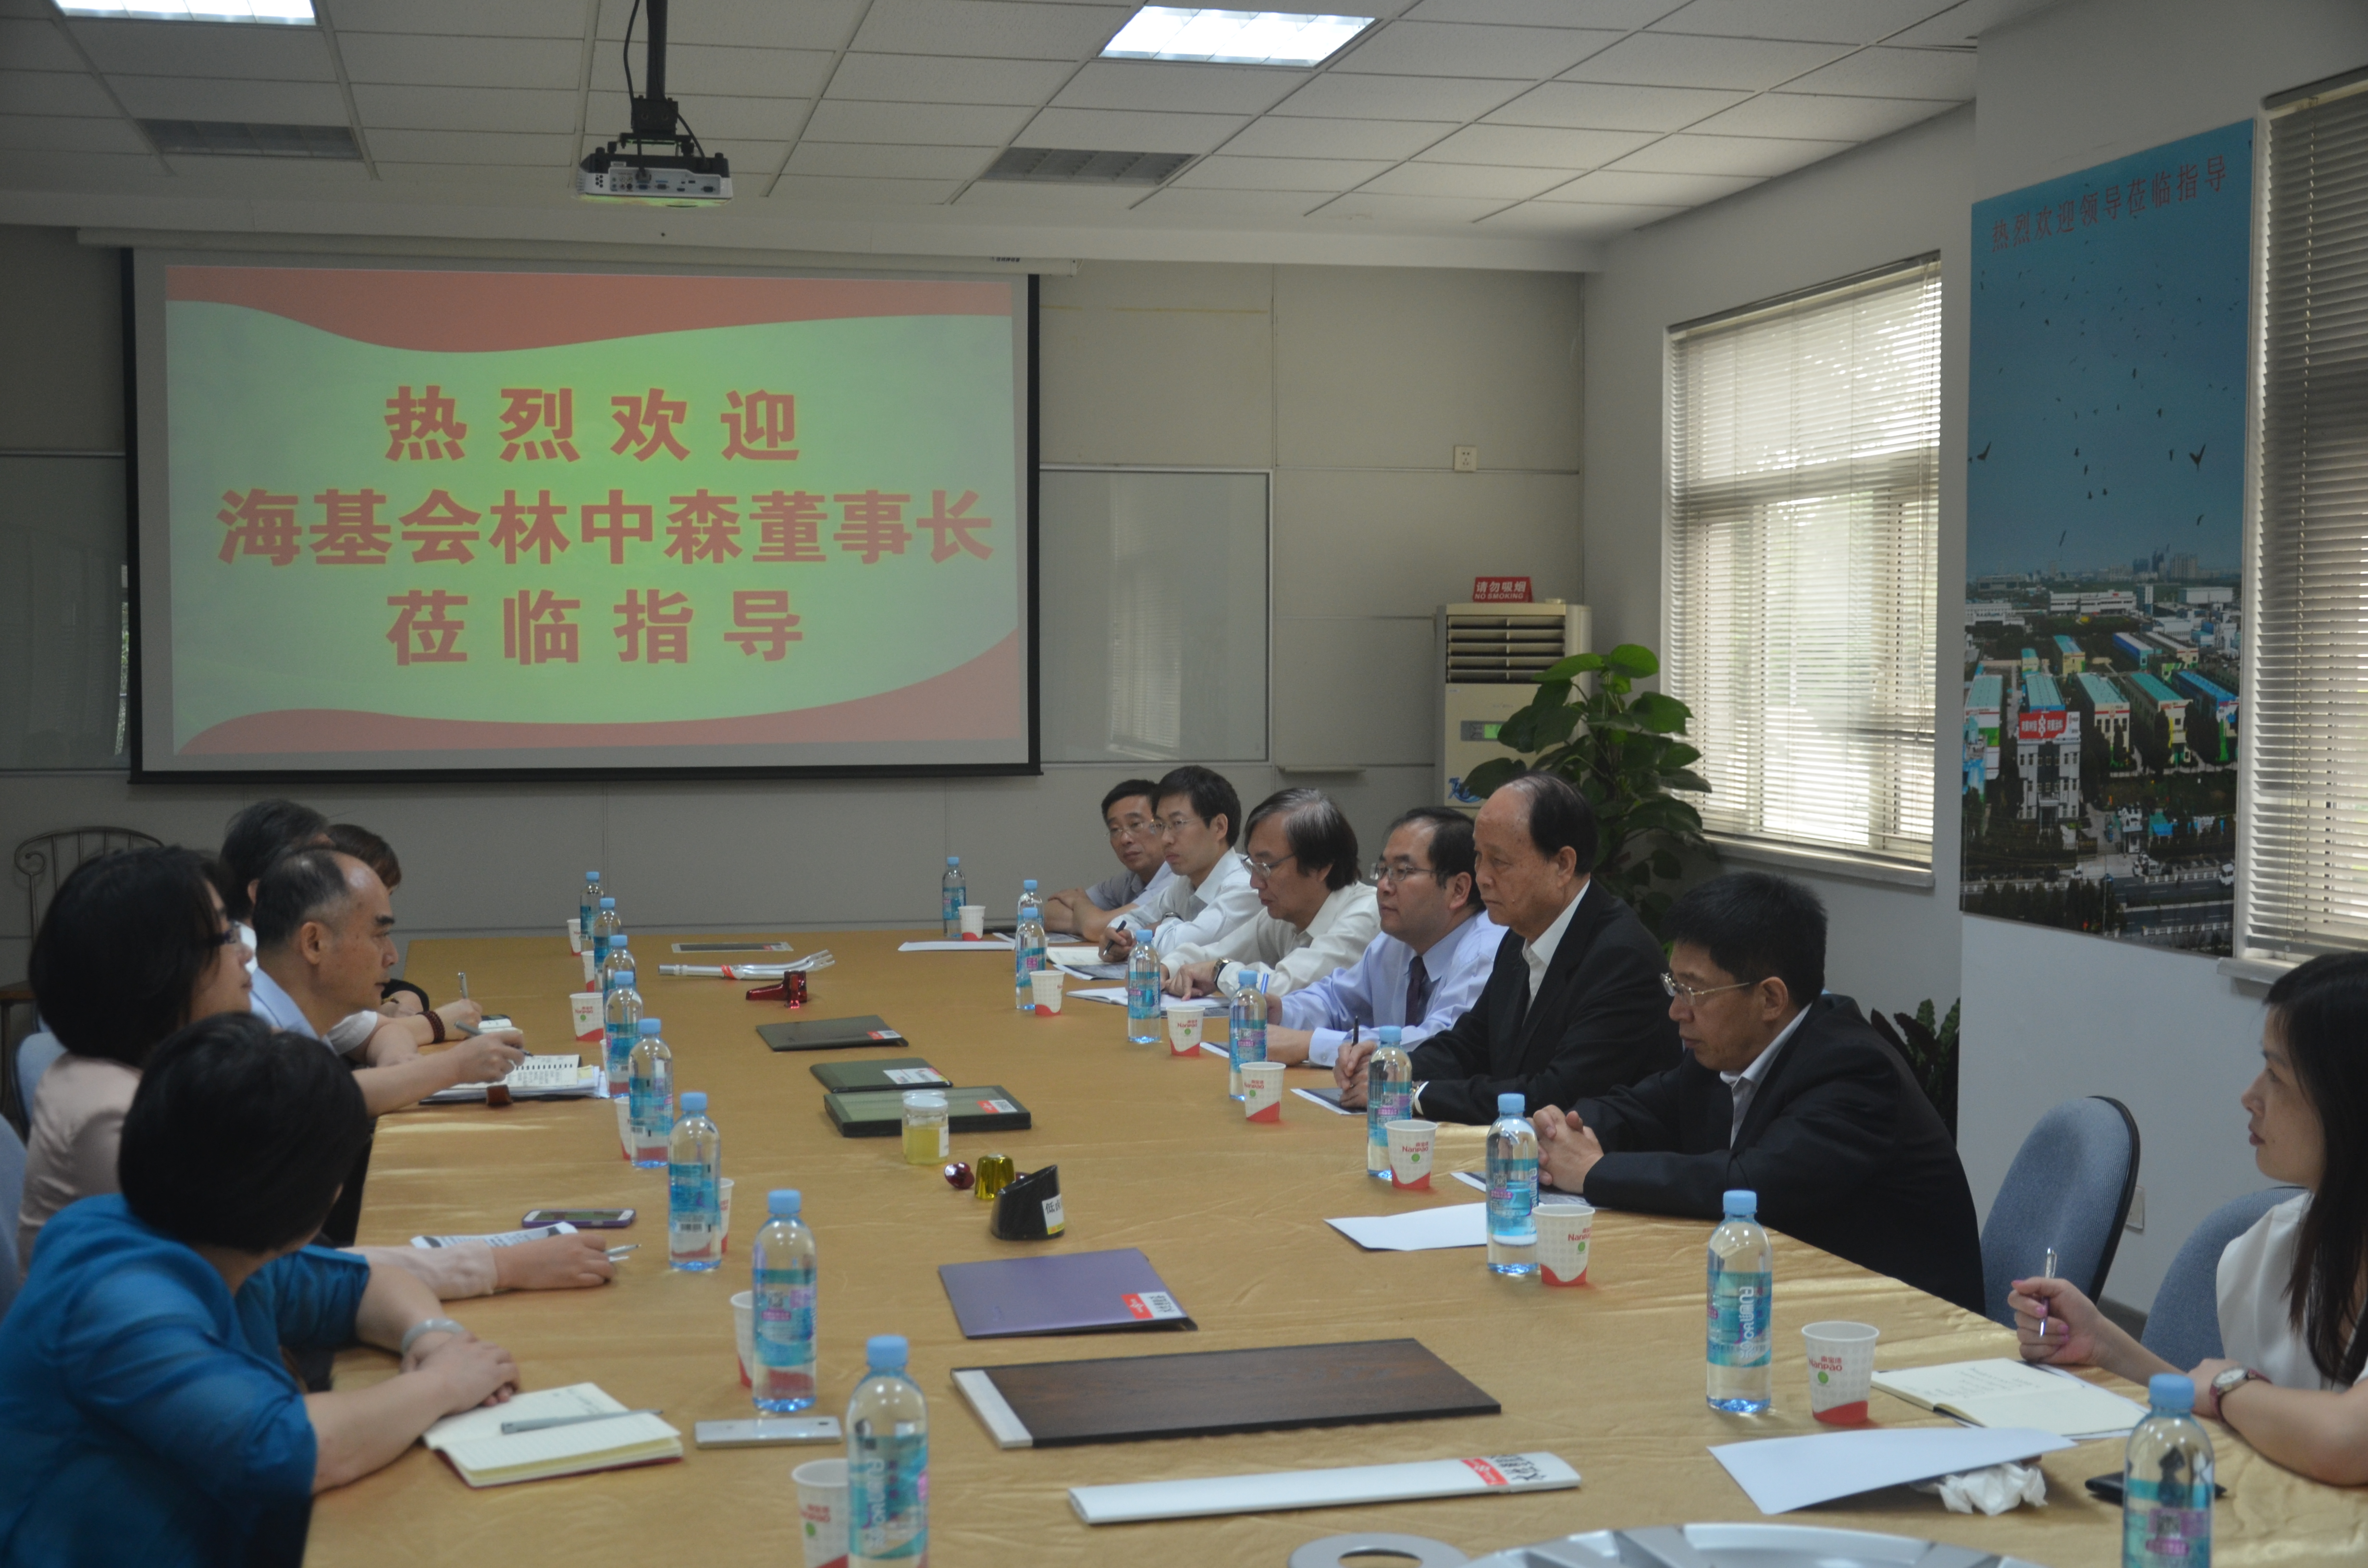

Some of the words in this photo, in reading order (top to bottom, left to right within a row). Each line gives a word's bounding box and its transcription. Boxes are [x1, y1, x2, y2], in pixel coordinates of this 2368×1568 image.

[1991, 154, 2227, 253] 热烈欢迎领导莅临指导
[384, 385, 801, 463] 热烈欢迎
[216, 488, 994, 567] 海基会林中森董事长
[1476, 581, 1527, 593] 请勿吸烟
[385, 589, 804, 667] 莅临指导
[1809, 1357, 1843, 1372] Nanpao
